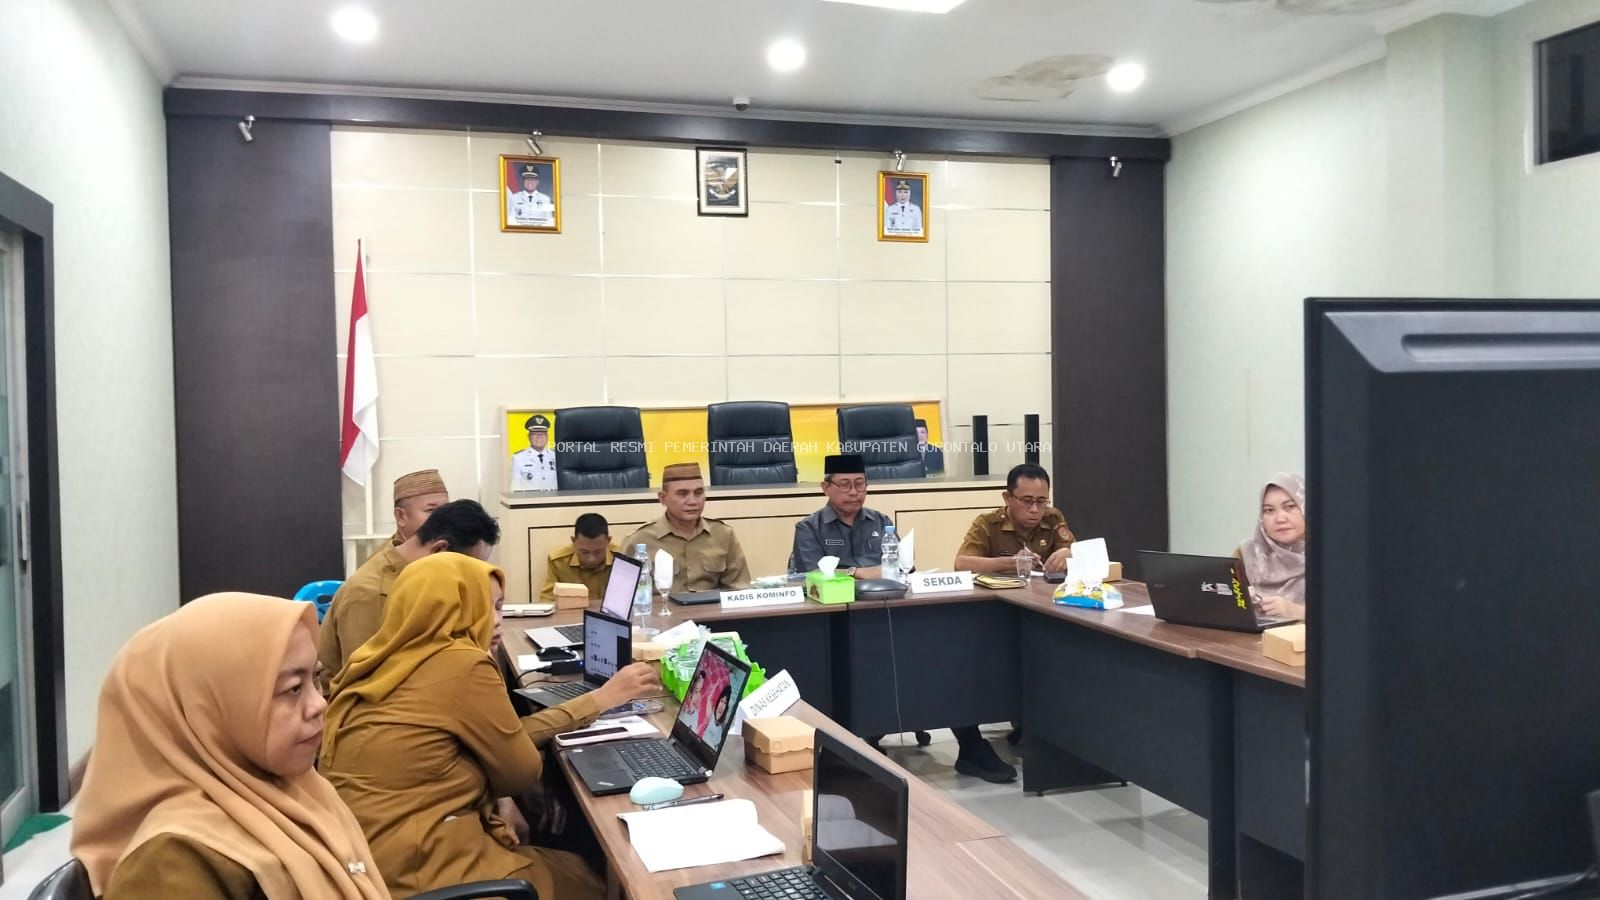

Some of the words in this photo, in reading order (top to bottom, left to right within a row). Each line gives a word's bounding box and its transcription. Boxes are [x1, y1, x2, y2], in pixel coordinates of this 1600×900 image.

[922, 575, 963, 588] SEKDA
[727, 593, 754, 602] KADIS
[757, 590, 797, 600] KOMINFO
